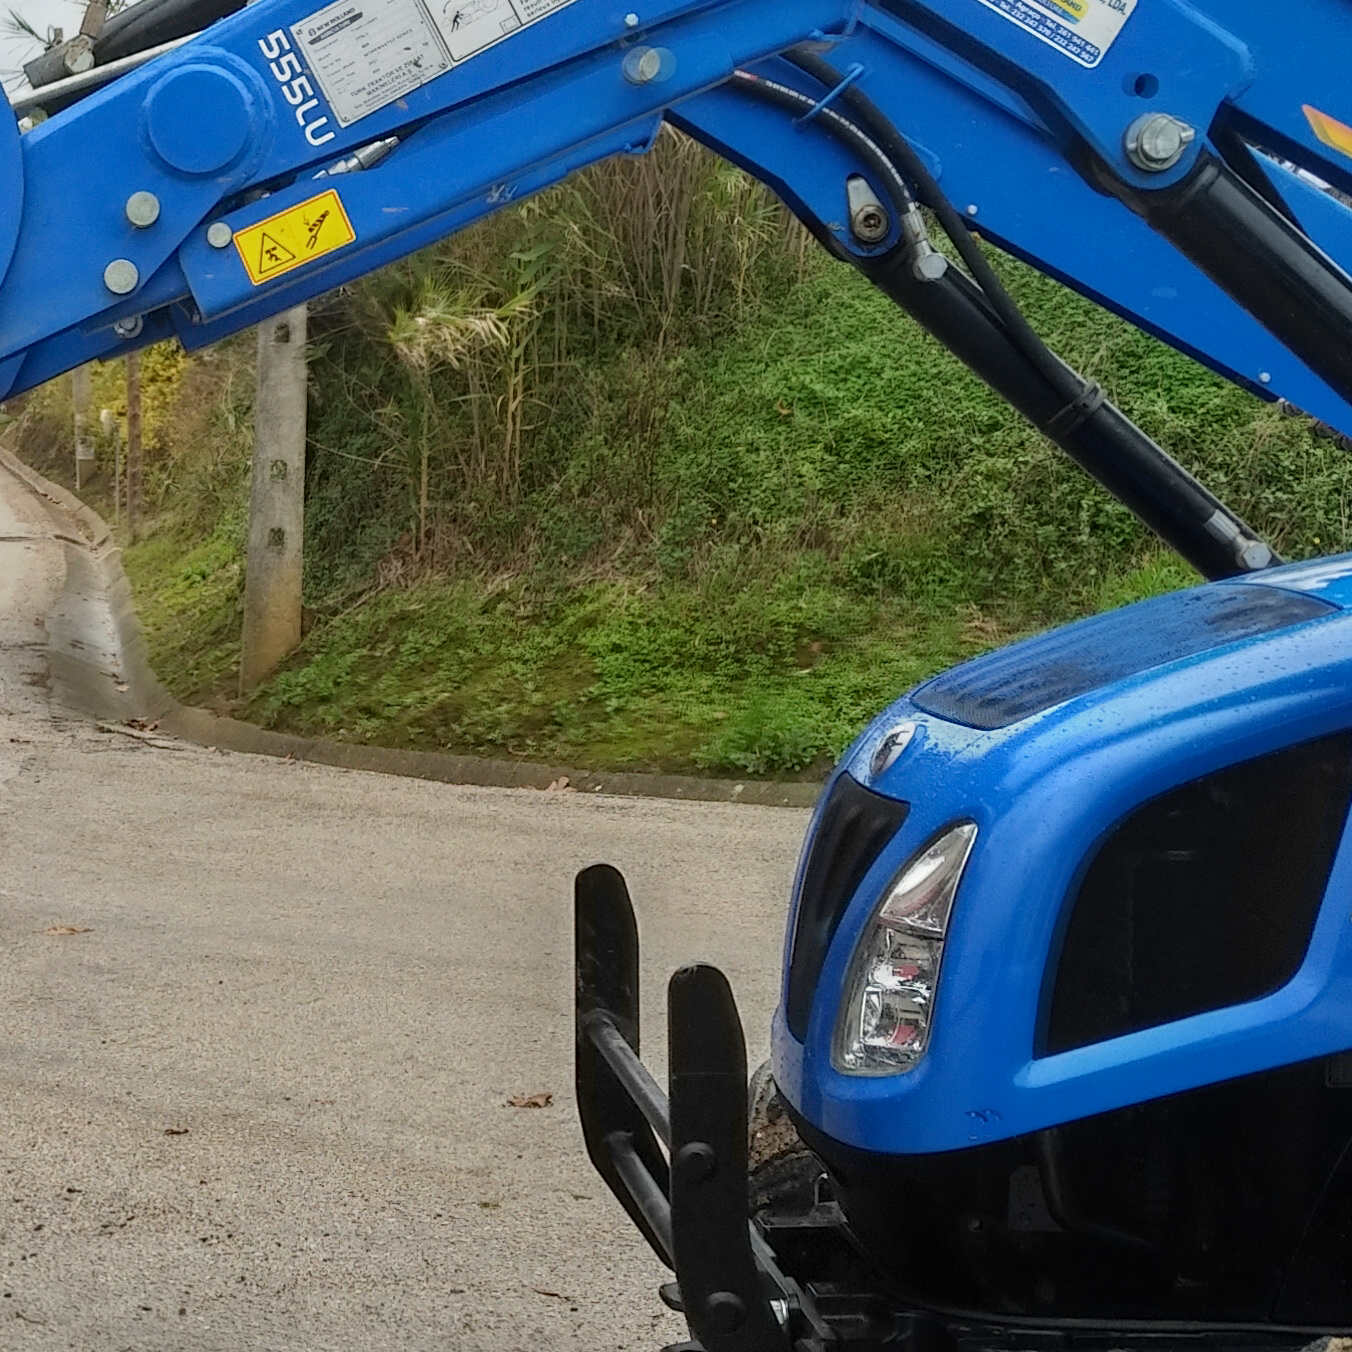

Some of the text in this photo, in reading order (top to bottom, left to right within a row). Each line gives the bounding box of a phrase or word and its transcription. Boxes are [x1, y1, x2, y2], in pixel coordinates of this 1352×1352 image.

[316, 7, 355, 31] NEW HOLLAND
[258, 29, 335, 146] 555LU
